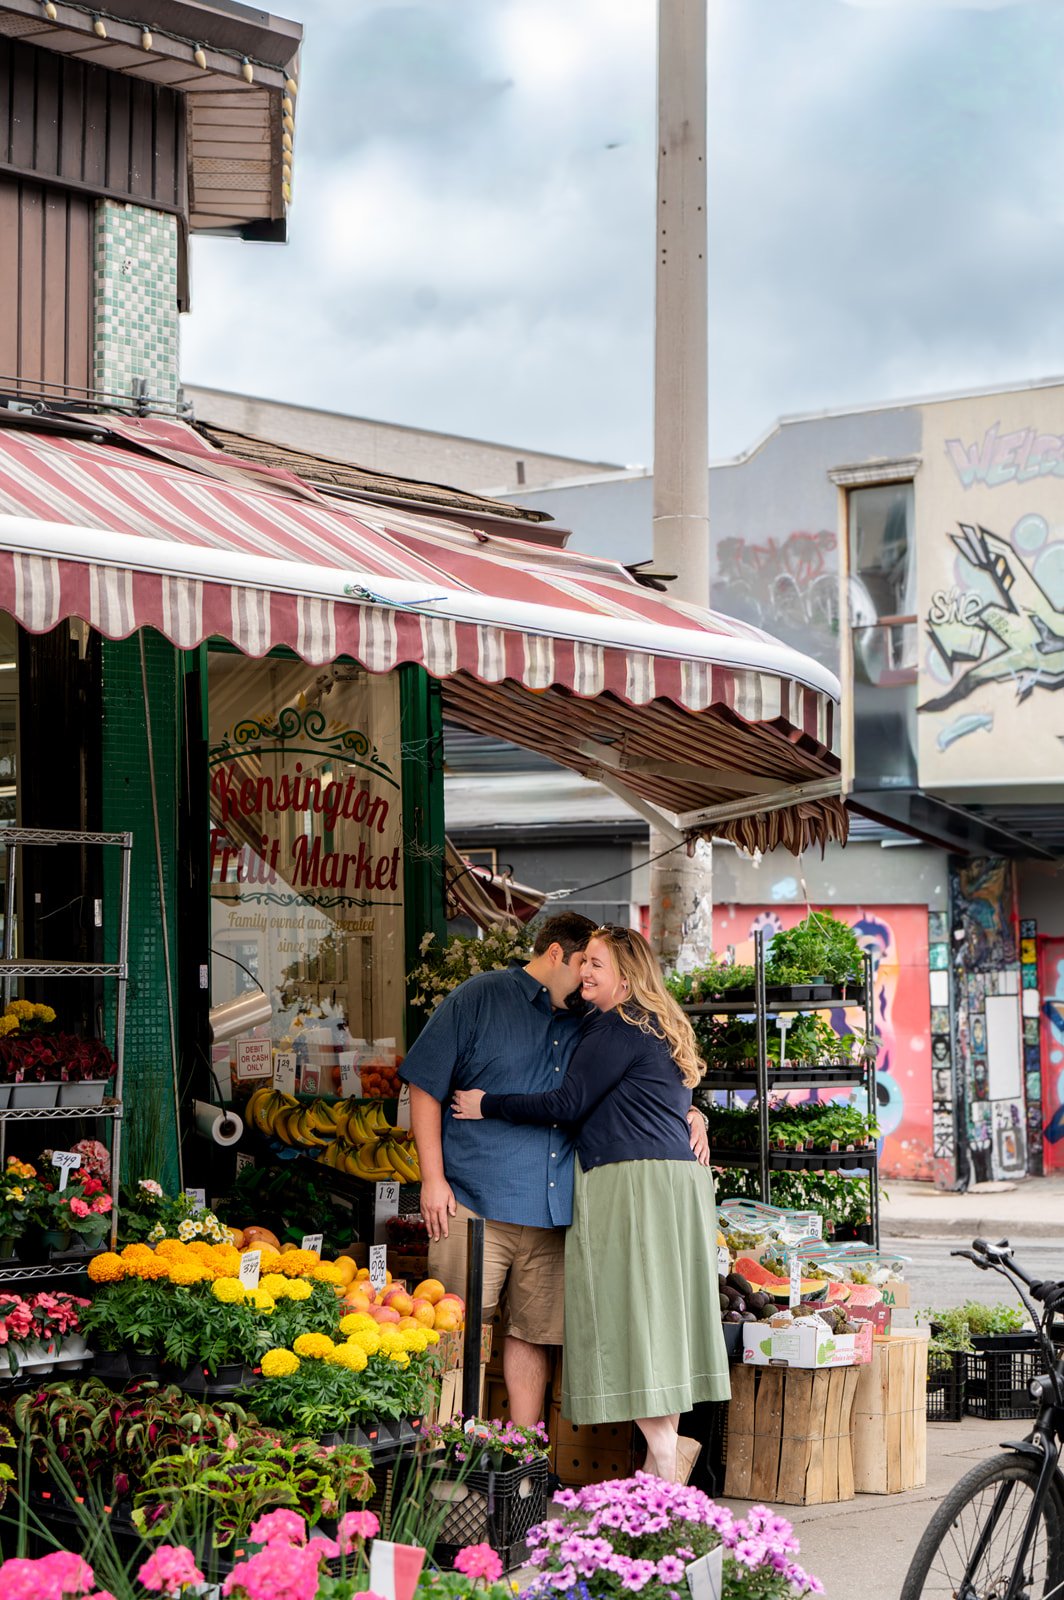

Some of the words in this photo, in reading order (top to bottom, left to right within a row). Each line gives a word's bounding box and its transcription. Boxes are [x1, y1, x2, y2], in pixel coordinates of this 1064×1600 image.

[212, 762, 389, 834] Kensington
[209, 828, 280, 884] Fruit
[292, 834, 400, 891] Market
[228, 911, 268, 933] Family
[270, 915, 305, 930] owned
[307, 916, 328, 930] and
[332, 917, 375, 933] perated
[277, 938, 305, 953] since
[245, 1045, 263, 1054] DEBIT
[241, 1055, 251, 1063] OR
[251, 1053, 269, 1062] CASH
[246, 1063, 264, 1072] ONLY
